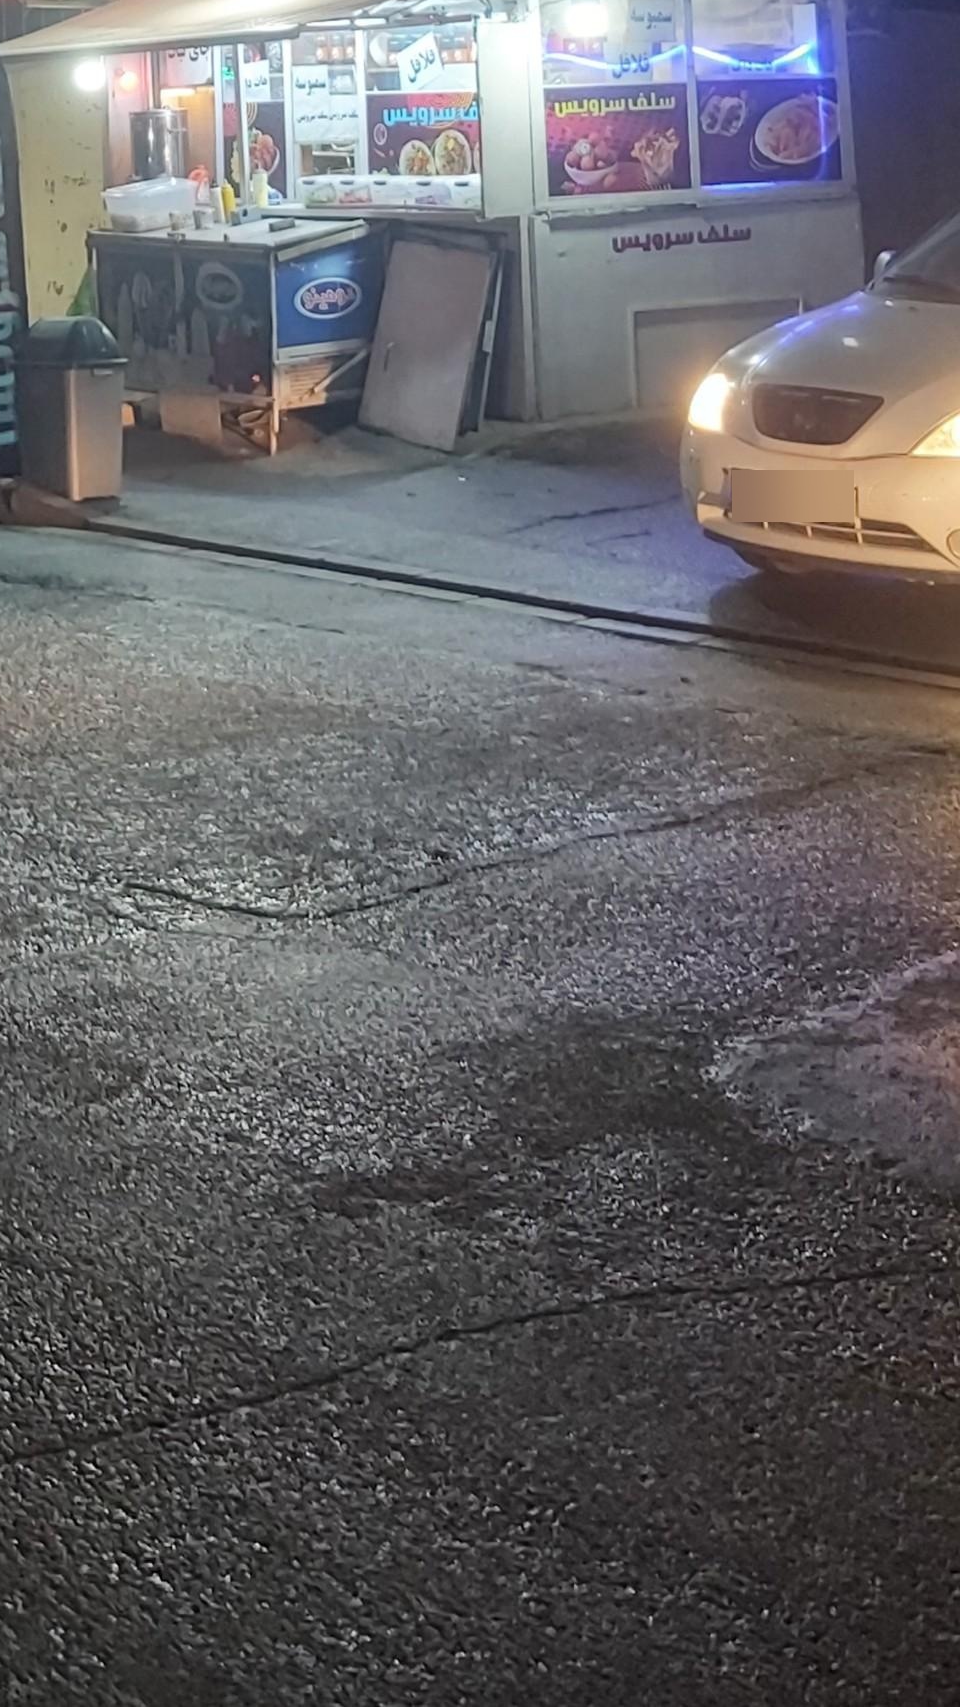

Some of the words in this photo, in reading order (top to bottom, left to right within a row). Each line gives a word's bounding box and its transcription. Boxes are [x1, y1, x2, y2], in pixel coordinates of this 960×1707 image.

[407, 48, 436, 83] فلافل
[612, 52, 650, 79] فلافل
[554, 97, 626, 118] سرویس
[628, 92, 675, 111] سلف
[383, 105, 457, 127] سرویس
[612, 231, 695, 253] سرویس
[697, 224, 752, 244] سلف
